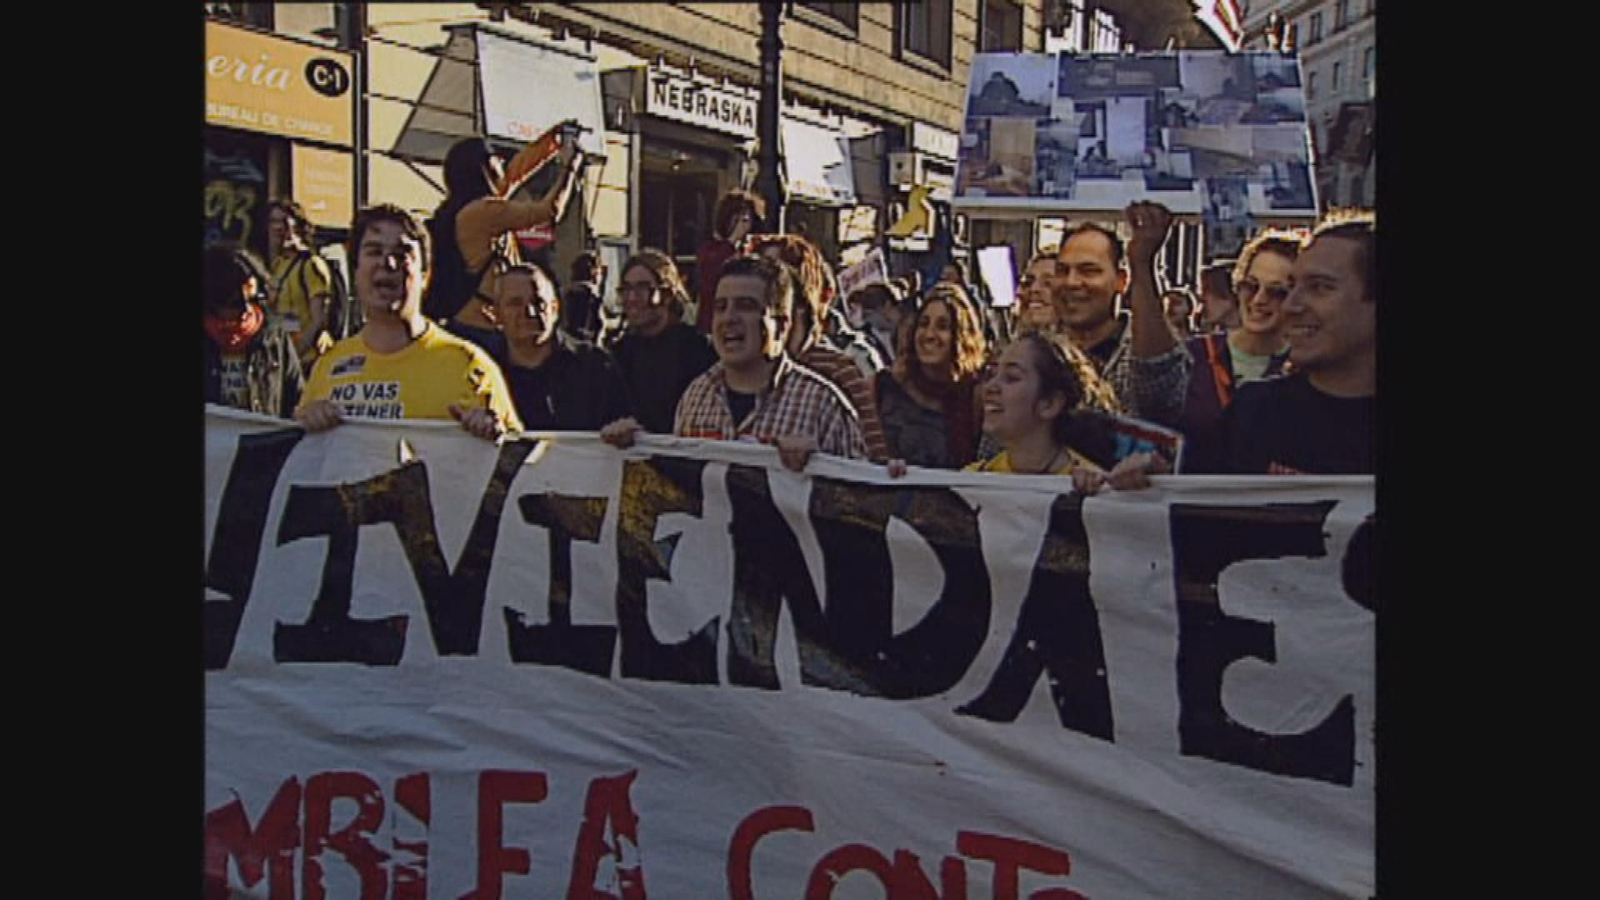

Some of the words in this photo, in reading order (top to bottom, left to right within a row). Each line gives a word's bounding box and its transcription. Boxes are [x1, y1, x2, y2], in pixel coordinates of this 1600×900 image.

[652, 80, 755, 129] NEBRASKA
[330, 384, 356, 401] NO
[362, 383, 398, 401] VAS
[1169, 500, 1376, 786] E
